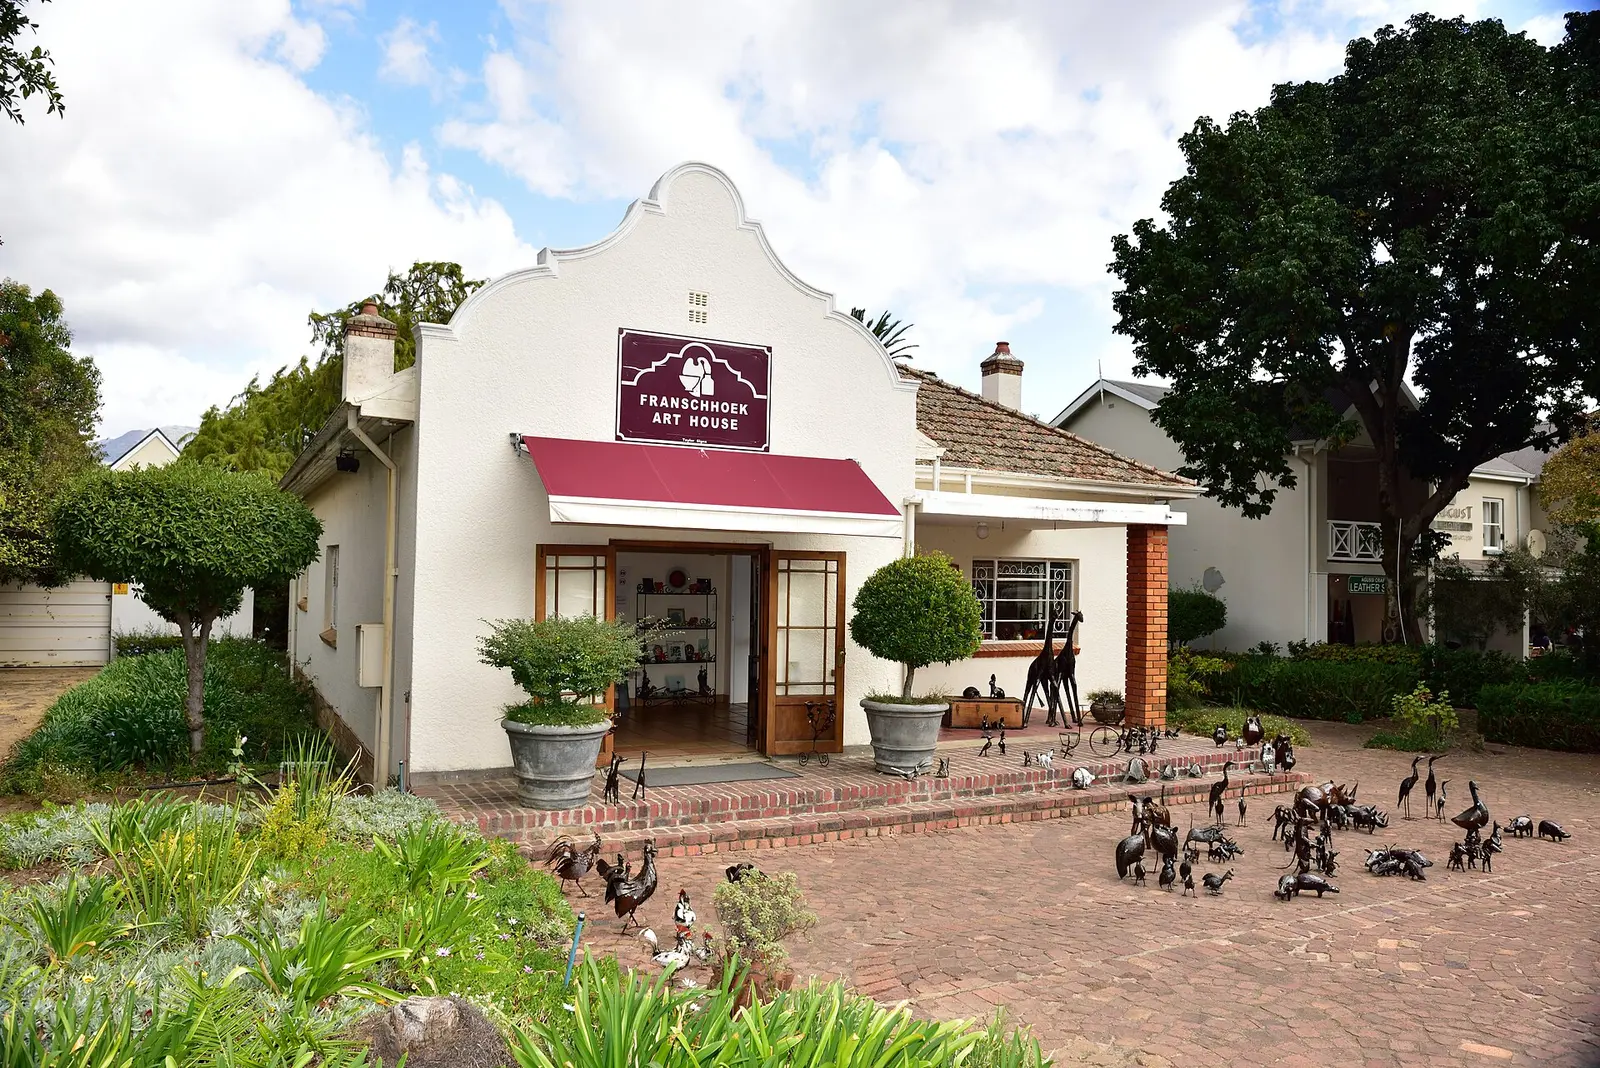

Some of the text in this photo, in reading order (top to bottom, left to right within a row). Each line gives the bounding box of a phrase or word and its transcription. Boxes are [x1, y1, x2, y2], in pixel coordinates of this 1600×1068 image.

[640, 394, 748, 415] FRANSCHHOEK
[652, 412, 738, 430] ART HOUSE
[1350, 582, 1380, 592] LEATHER
